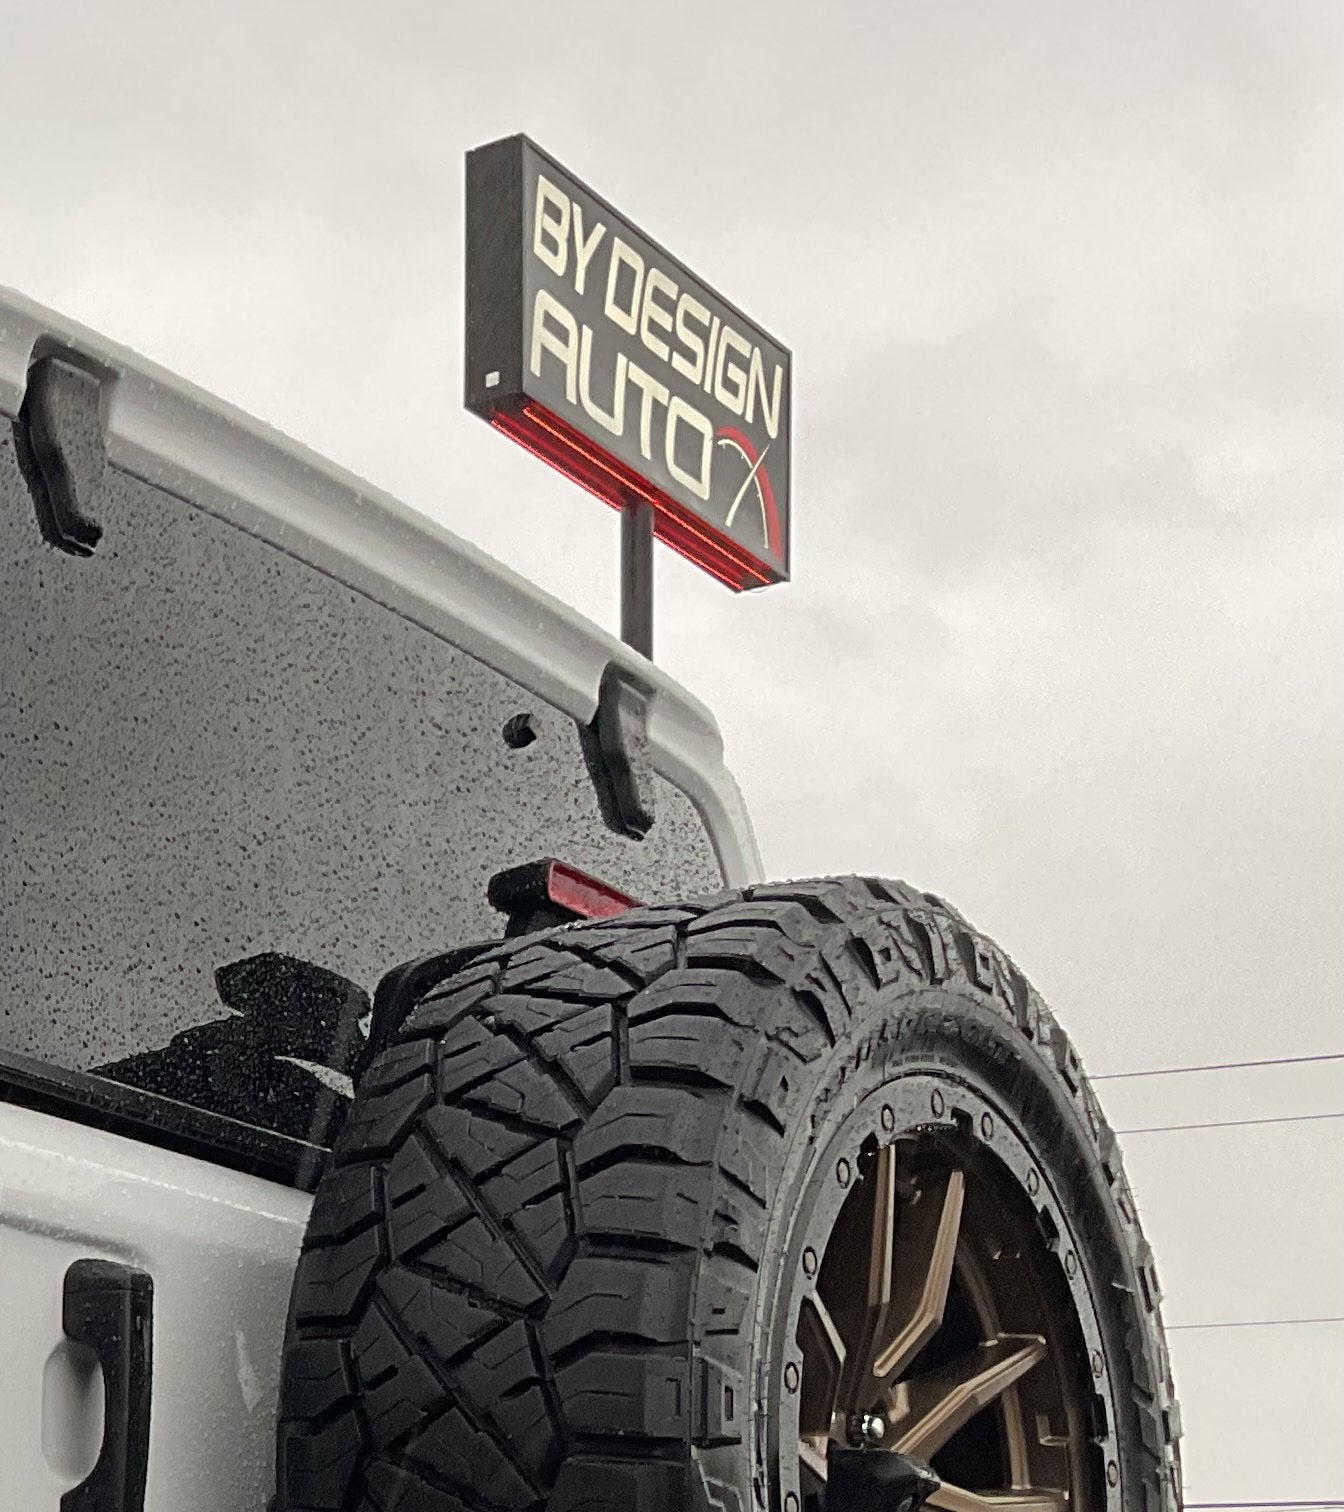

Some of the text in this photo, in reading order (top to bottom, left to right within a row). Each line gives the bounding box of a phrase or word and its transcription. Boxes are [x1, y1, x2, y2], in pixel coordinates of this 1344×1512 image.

[529, 289, 713, 501] AUTO
[533, 174, 784, 439] BY DESIGN
